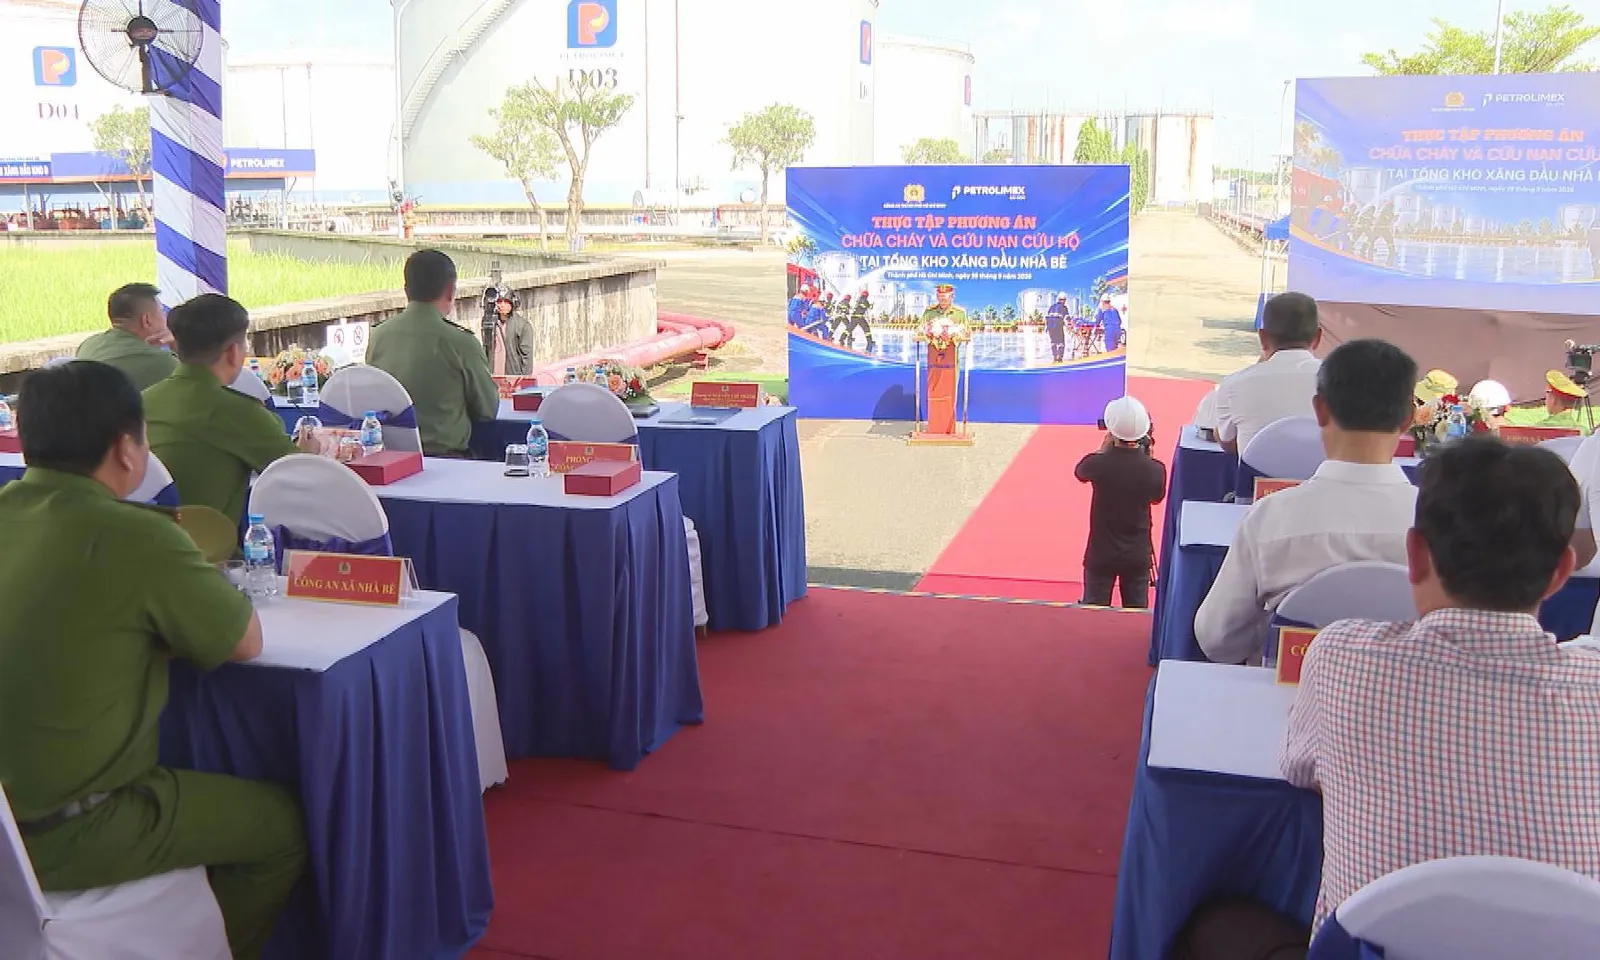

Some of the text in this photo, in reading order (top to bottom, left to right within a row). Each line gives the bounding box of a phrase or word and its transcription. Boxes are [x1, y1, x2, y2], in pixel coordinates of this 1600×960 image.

[1496, 93, 1565, 102] PETROLIMEX
[230, 157, 285, 168] PETROLIMEX
[1453, 168, 1482, 180] KHO
[963, 185, 1026, 195] PETROLIMEX
[915, 213, 944, 231] TẬP
[1013, 214, 1037, 229] ÁN
[842, 232, 883, 248] CHỮA
[886, 232, 925, 248] CHÁY
[929, 232, 948, 248] VÀ
[951, 232, 983, 248] CỨU
[1021, 232, 1054, 249] CỨU
[922, 256, 948, 268] KHO
[951, 252, 988, 268] XĂNG
[991, 249, 1017, 270] DẦU
[1020, 252, 1047, 269] NHÀ
[1050, 253, 1068, 269] BÈ
[294, 575, 323, 589] CÔNG
[325, 579, 339, 590] AN
[341, 579, 356, 592] XÃ
[358, 580, 379, 593] NHÀ
